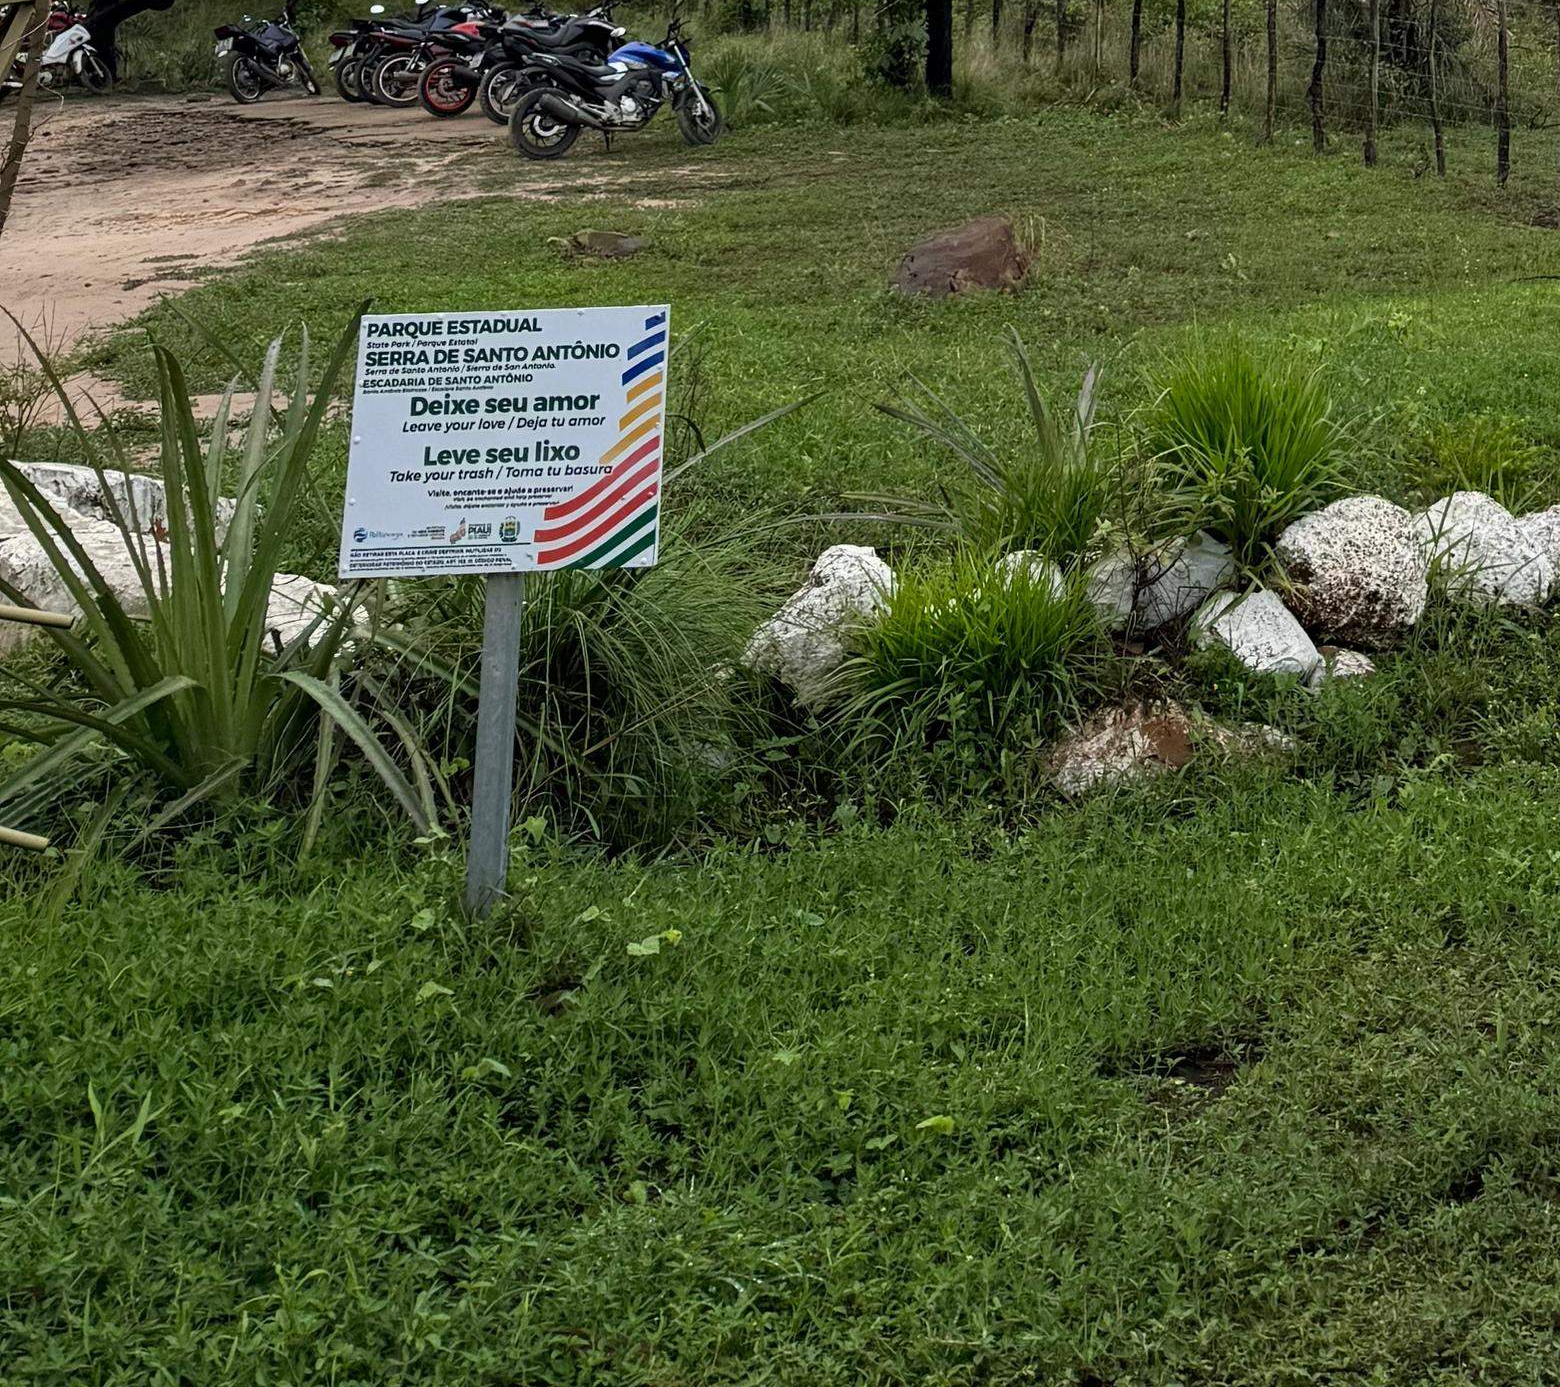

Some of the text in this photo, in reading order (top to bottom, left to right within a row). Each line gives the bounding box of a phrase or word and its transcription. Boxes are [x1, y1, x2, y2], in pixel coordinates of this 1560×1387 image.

[367, 318, 542, 339] PARQUE ESTADUAL
[365, 340, 620, 367] SERRA DE SANTO ANTÔNIO
[367, 341, 389, 349] State
[391, 340, 411, 348] Park
[417, 339, 447, 348] Parque
[448, 338, 478, 347] Estatal
[365, 368, 387, 376] Serra
[389, 367, 400, 375] de
[401, 366, 425, 374] Santo
[466, 364, 490, 372] Sierra
[492, 363, 502, 371] de
[505, 363, 518, 371] San
[362, 373, 533, 388] ESCADARIA DE SANTO ANTÔNIO
[410, 393, 600, 417] Deixe seu amor
[402, 416, 606, 433] Leave your love / Deja tu amor
[424, 439, 580, 466] Leve seu lixo
[389, 463, 613, 483] Take your trash / Toma tu basura
